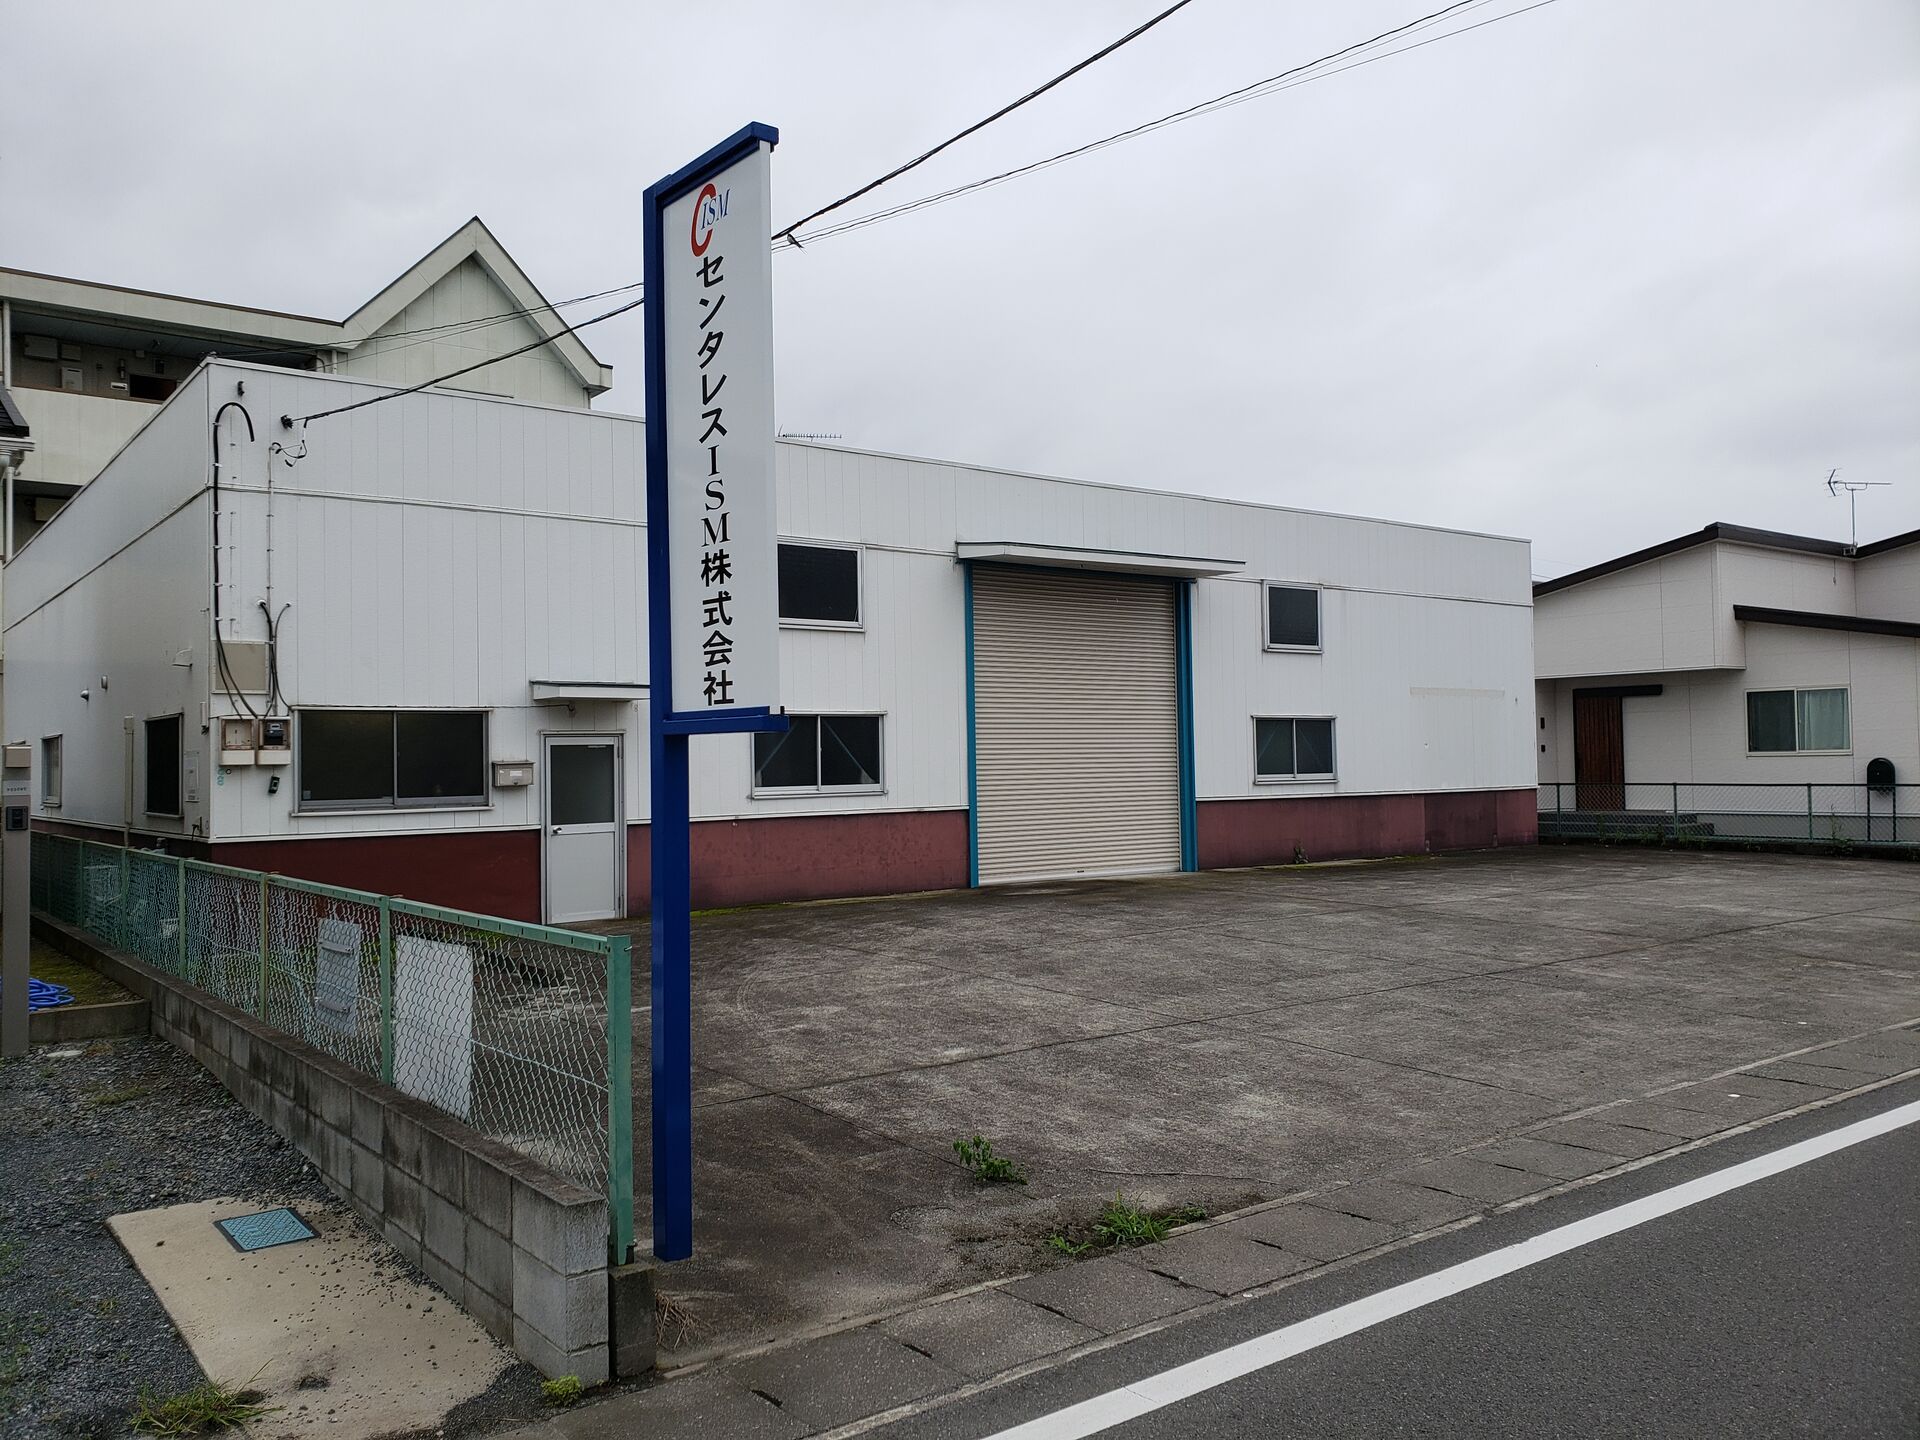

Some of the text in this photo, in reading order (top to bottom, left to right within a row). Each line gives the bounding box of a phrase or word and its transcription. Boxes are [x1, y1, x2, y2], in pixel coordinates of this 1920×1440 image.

[696, 255, 734, 706] センタレスISM株式会社
